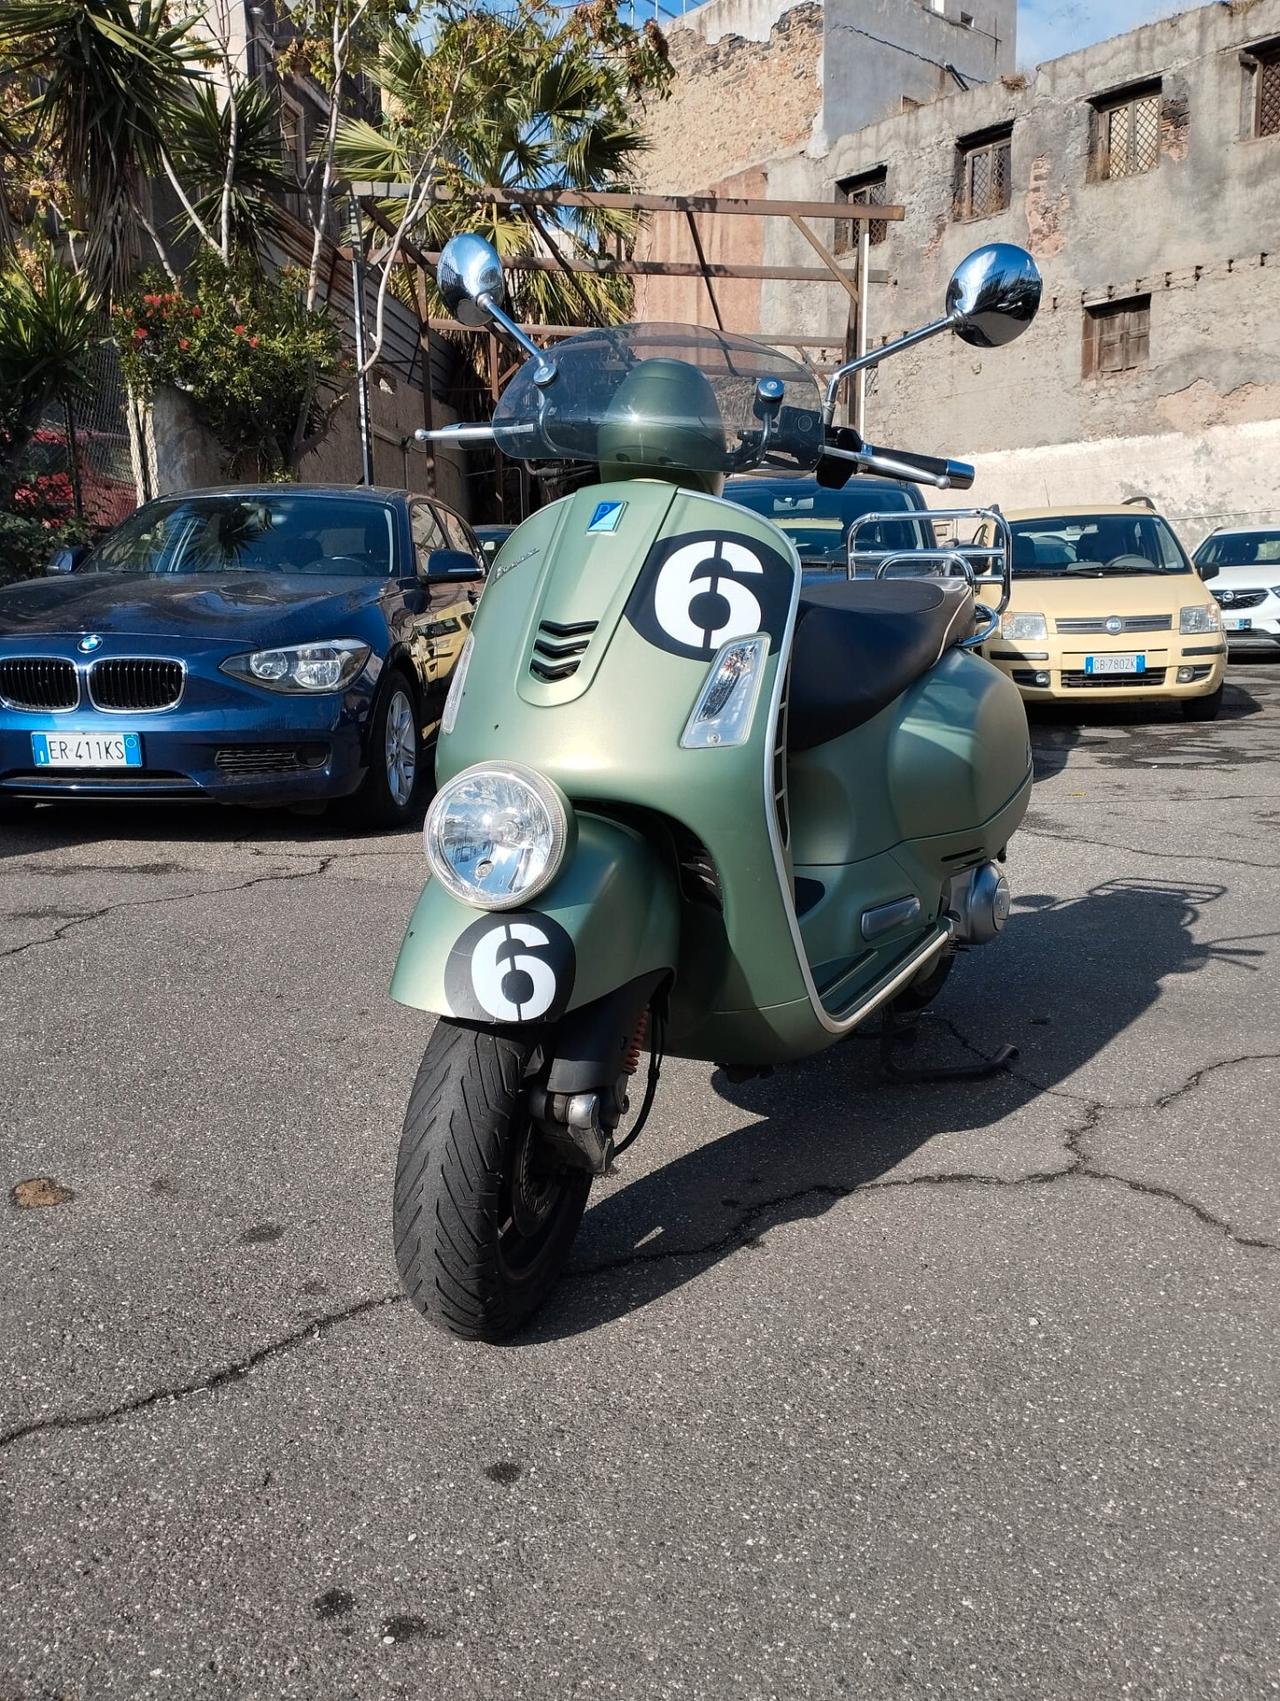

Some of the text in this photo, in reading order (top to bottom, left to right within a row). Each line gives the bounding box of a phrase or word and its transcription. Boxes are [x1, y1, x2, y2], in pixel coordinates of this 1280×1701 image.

[654, 540, 764, 650] 6
[48, 740, 125, 760] ER 411KS
[471, 923, 556, 1022] 6
